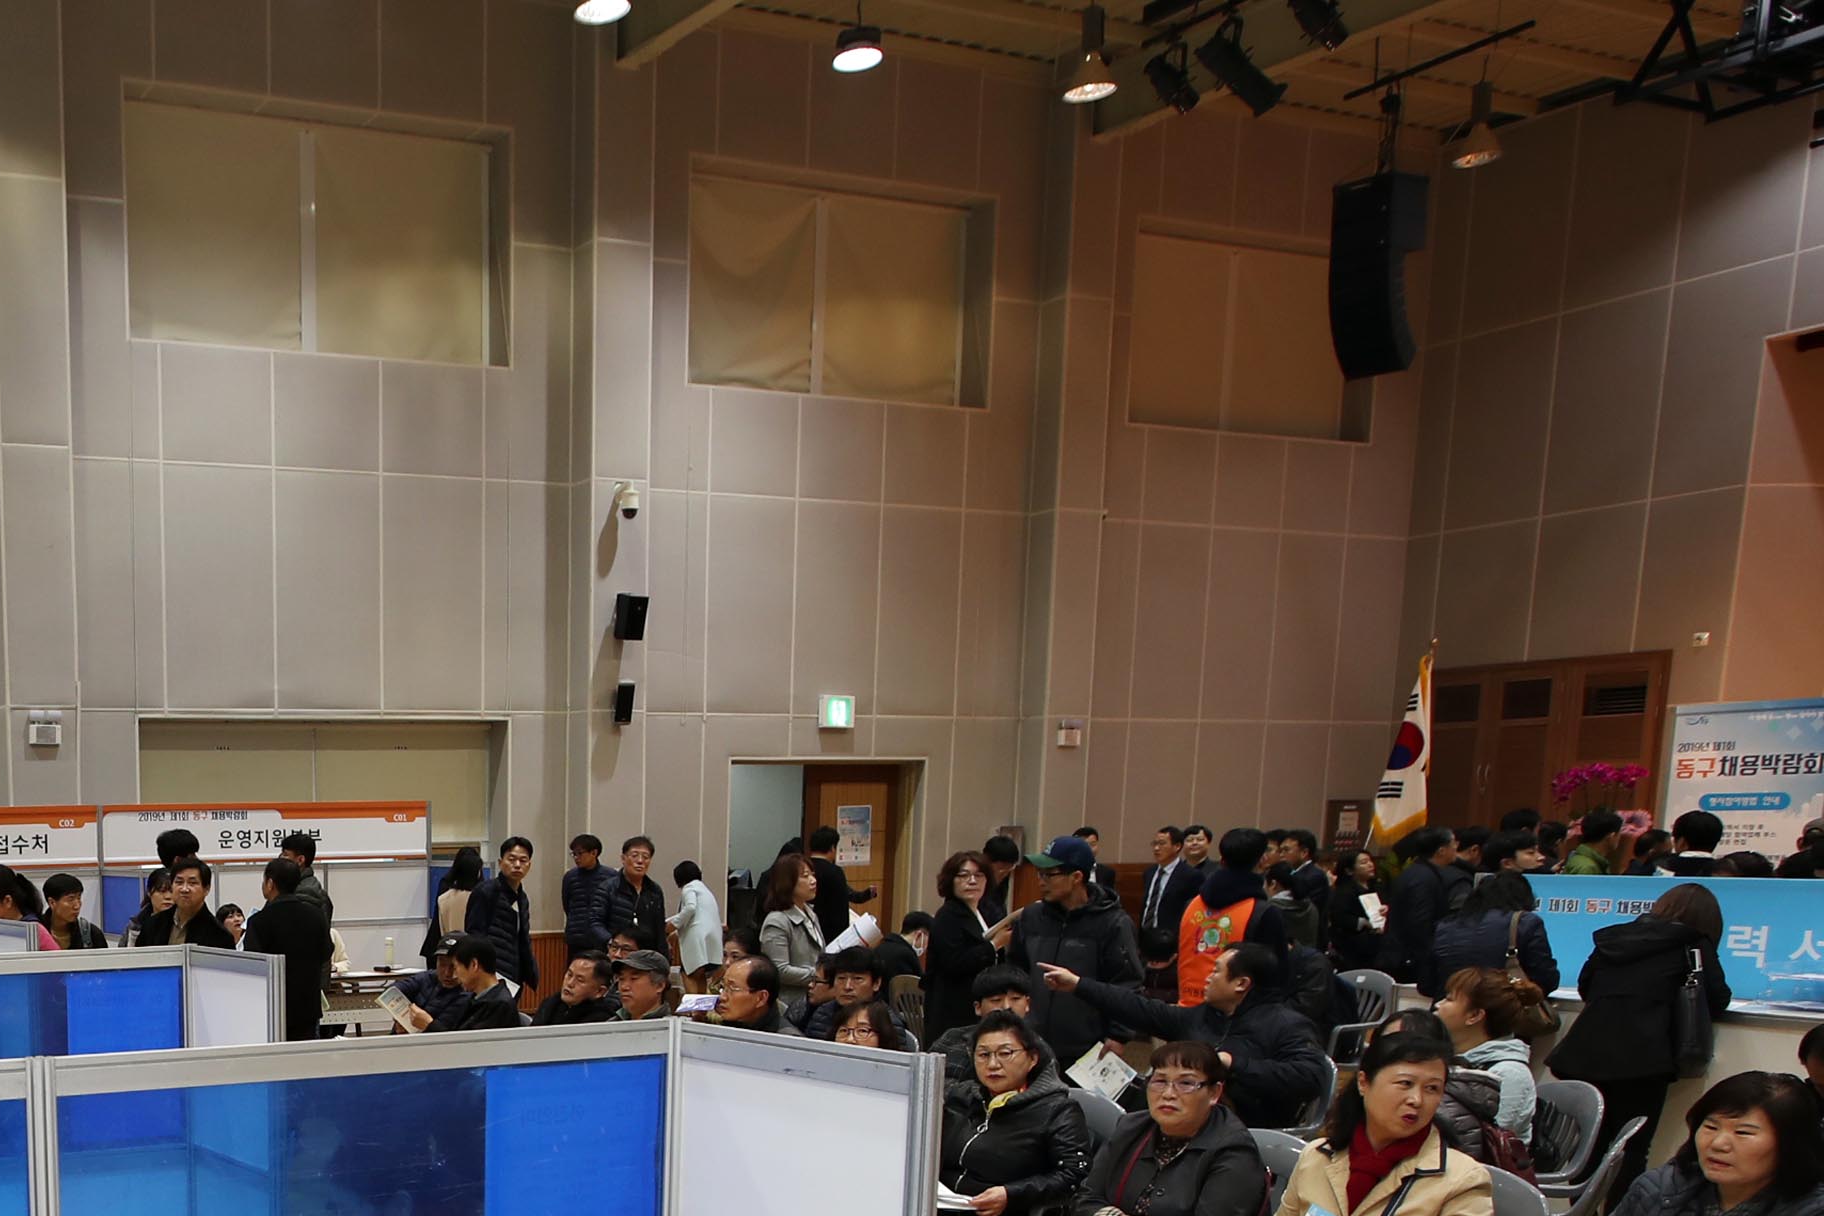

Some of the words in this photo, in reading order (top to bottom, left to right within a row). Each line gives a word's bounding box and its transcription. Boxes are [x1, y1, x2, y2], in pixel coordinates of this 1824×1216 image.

[1677, 742, 1710, 753] 2019년
[1676, 757, 1717, 780] 동구
[1718, 753, 1824, 777] 채용박람회
[138, 811, 166, 822] 2019년
[192, 811, 209, 821] 동구
[211, 810, 248, 821] 채용박람회
[393, 814, 407, 822] C01
[59, 819, 75, 828] C02
[218, 829, 323, 849] 운영지원부
[1549, 897, 1580, 913] 제1회
[1586, 899, 1613, 913] 동구
[1616, 899, 1655, 914] 채용박
